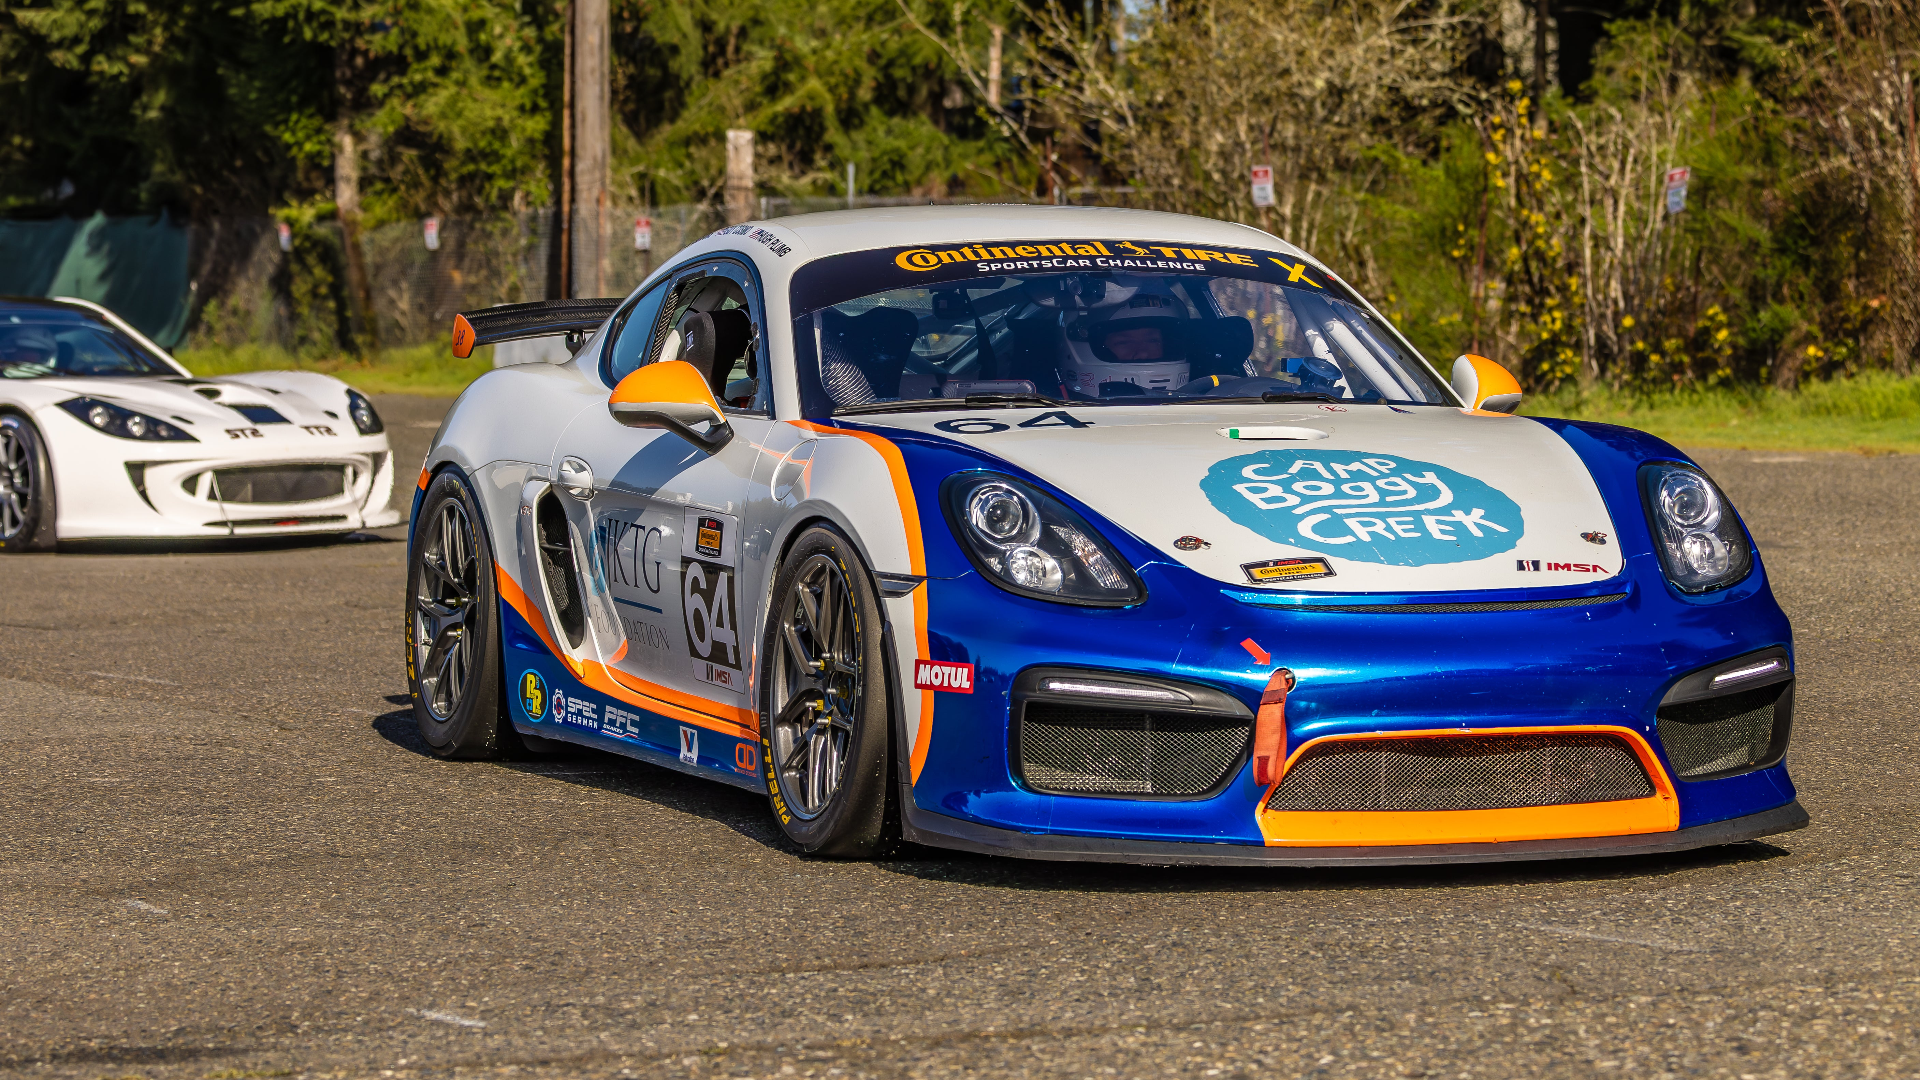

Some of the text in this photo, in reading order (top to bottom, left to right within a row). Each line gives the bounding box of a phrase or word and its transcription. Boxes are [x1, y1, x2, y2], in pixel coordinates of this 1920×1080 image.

[895, 241, 1259, 272] Continental TIRE
[1096, 257, 1206, 271] CHALLENGE
[933, 410, 1096, 434] 64
[1241, 458, 1398, 481] CAMP
[1297, 508, 1510, 545] CREEK
[1260, 564, 1308, 575] Continental
[1546, 562, 1611, 575] IMSA
[684, 561, 737, 665] 64
[916, 663, 971, 689] MOTUL
[567, 696, 598, 719] SPEC
[603, 704, 640, 734] PFC
[567, 713, 598, 730] GERMAN
[762, 737, 791, 825] PIRELLI
